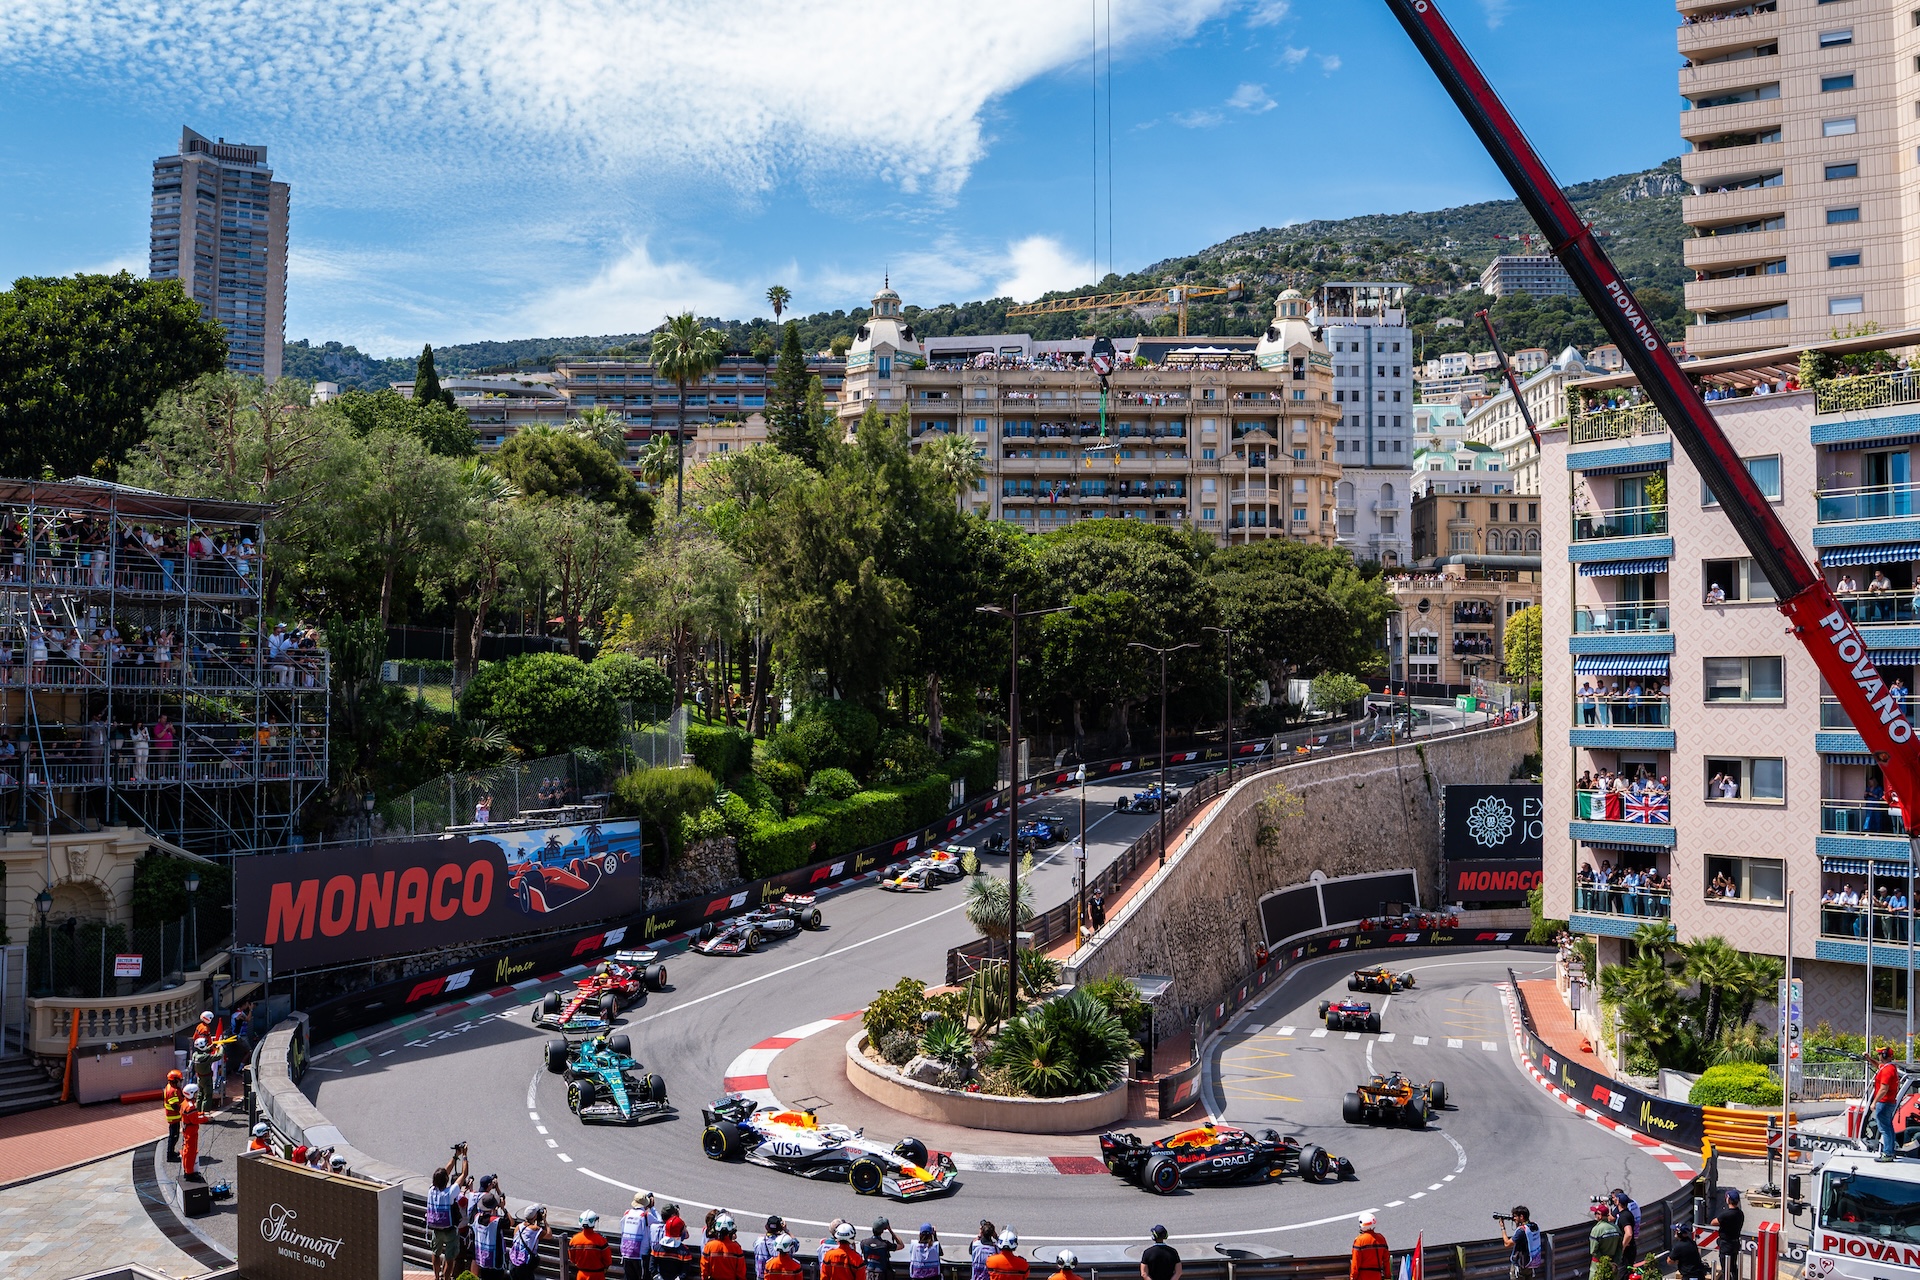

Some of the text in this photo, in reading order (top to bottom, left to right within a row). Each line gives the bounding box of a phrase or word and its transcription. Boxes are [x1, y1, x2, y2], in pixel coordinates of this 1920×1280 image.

[1606, 280, 1658, 351] PIOVANO
[1819, 610, 1912, 744] PIOVANO
[1520, 820, 1543, 844] JO
[854, 852, 876, 872] Monaco
[762, 880, 787, 903] Monaco
[1457, 871, 1543, 891] MONACO
[264, 859, 494, 945] MONACO
[644, 914, 677, 938] Monaco
[1430, 931, 1454, 944] Monaco
[571, 926, 628, 957] F1 75
[496, 956, 535, 983] Monaco
[405, 969, 475, 1003] F1 75
[1592, 1084, 1627, 1113] F1 75
[1639, 1100, 1678, 1133] Monaco
[773, 1142, 803, 1156] VISA
[845, 1147, 862, 1155] HUGO
[1176, 1154, 1191, 1164] Red
[1213, 1152, 1254, 1168] ORACLE
[260, 1202, 345, 1260] Fairmont
[278, 1246, 326, 1269] MONTE CARLO
[1822, 1234, 1920, 1267] PIOVAN
